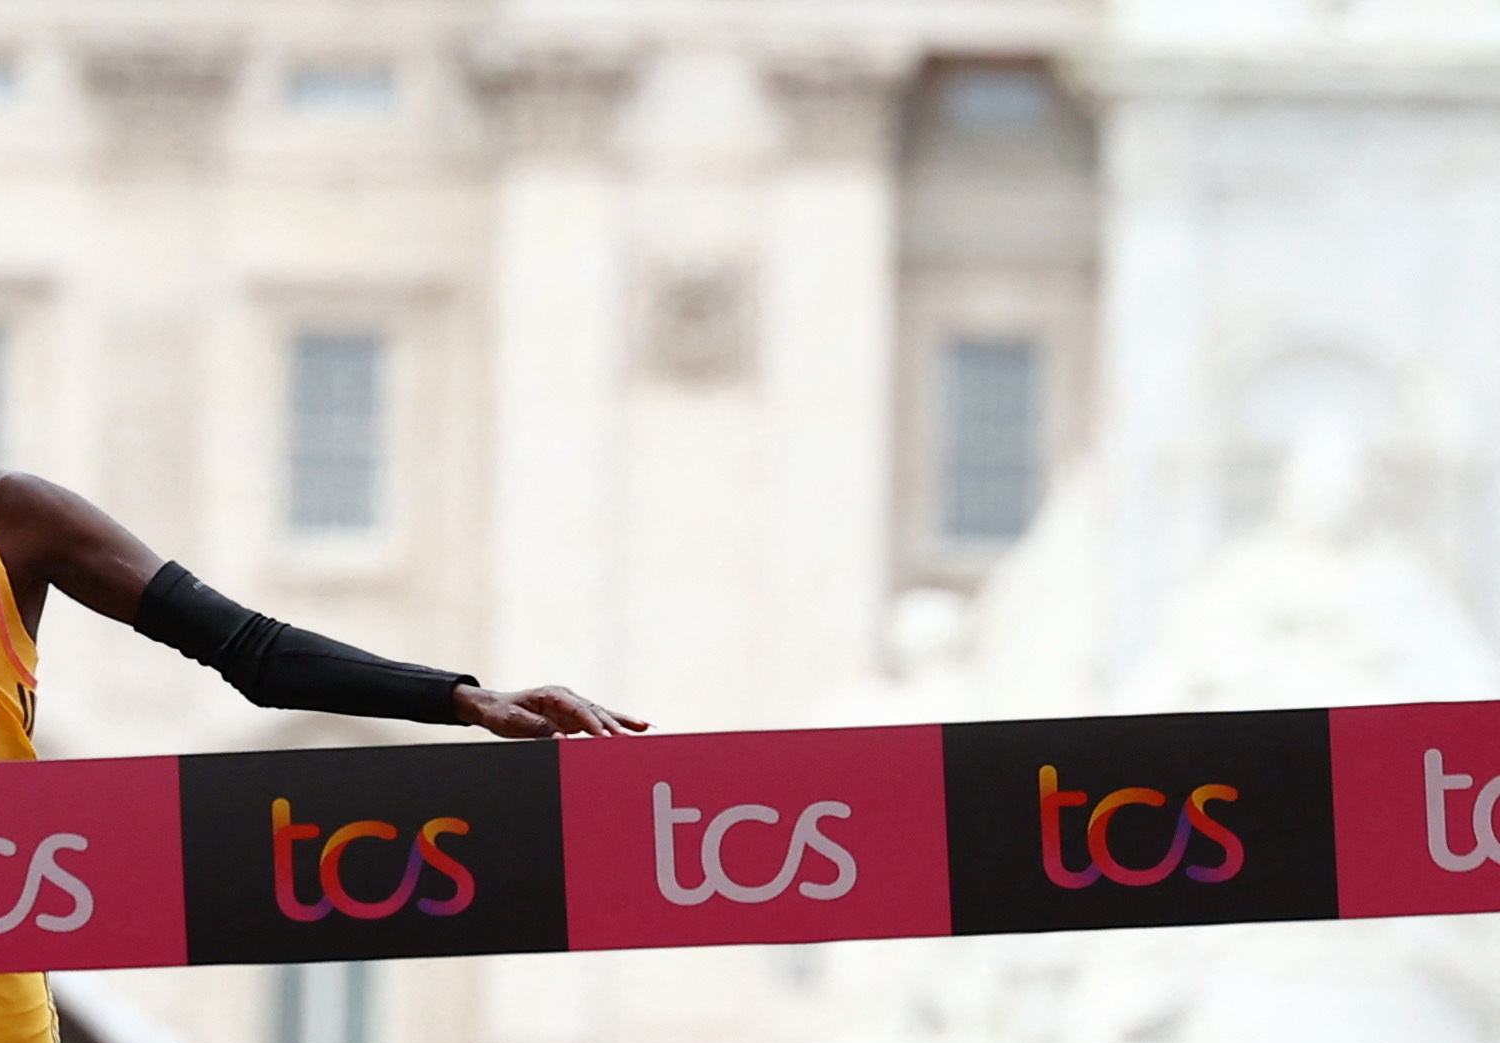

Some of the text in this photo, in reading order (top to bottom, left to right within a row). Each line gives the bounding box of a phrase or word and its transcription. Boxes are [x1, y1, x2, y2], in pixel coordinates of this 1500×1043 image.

[272, 798, 475, 922] tcs
[652, 781, 857, 906] tcs
[1038, 764, 1245, 889] tcs
